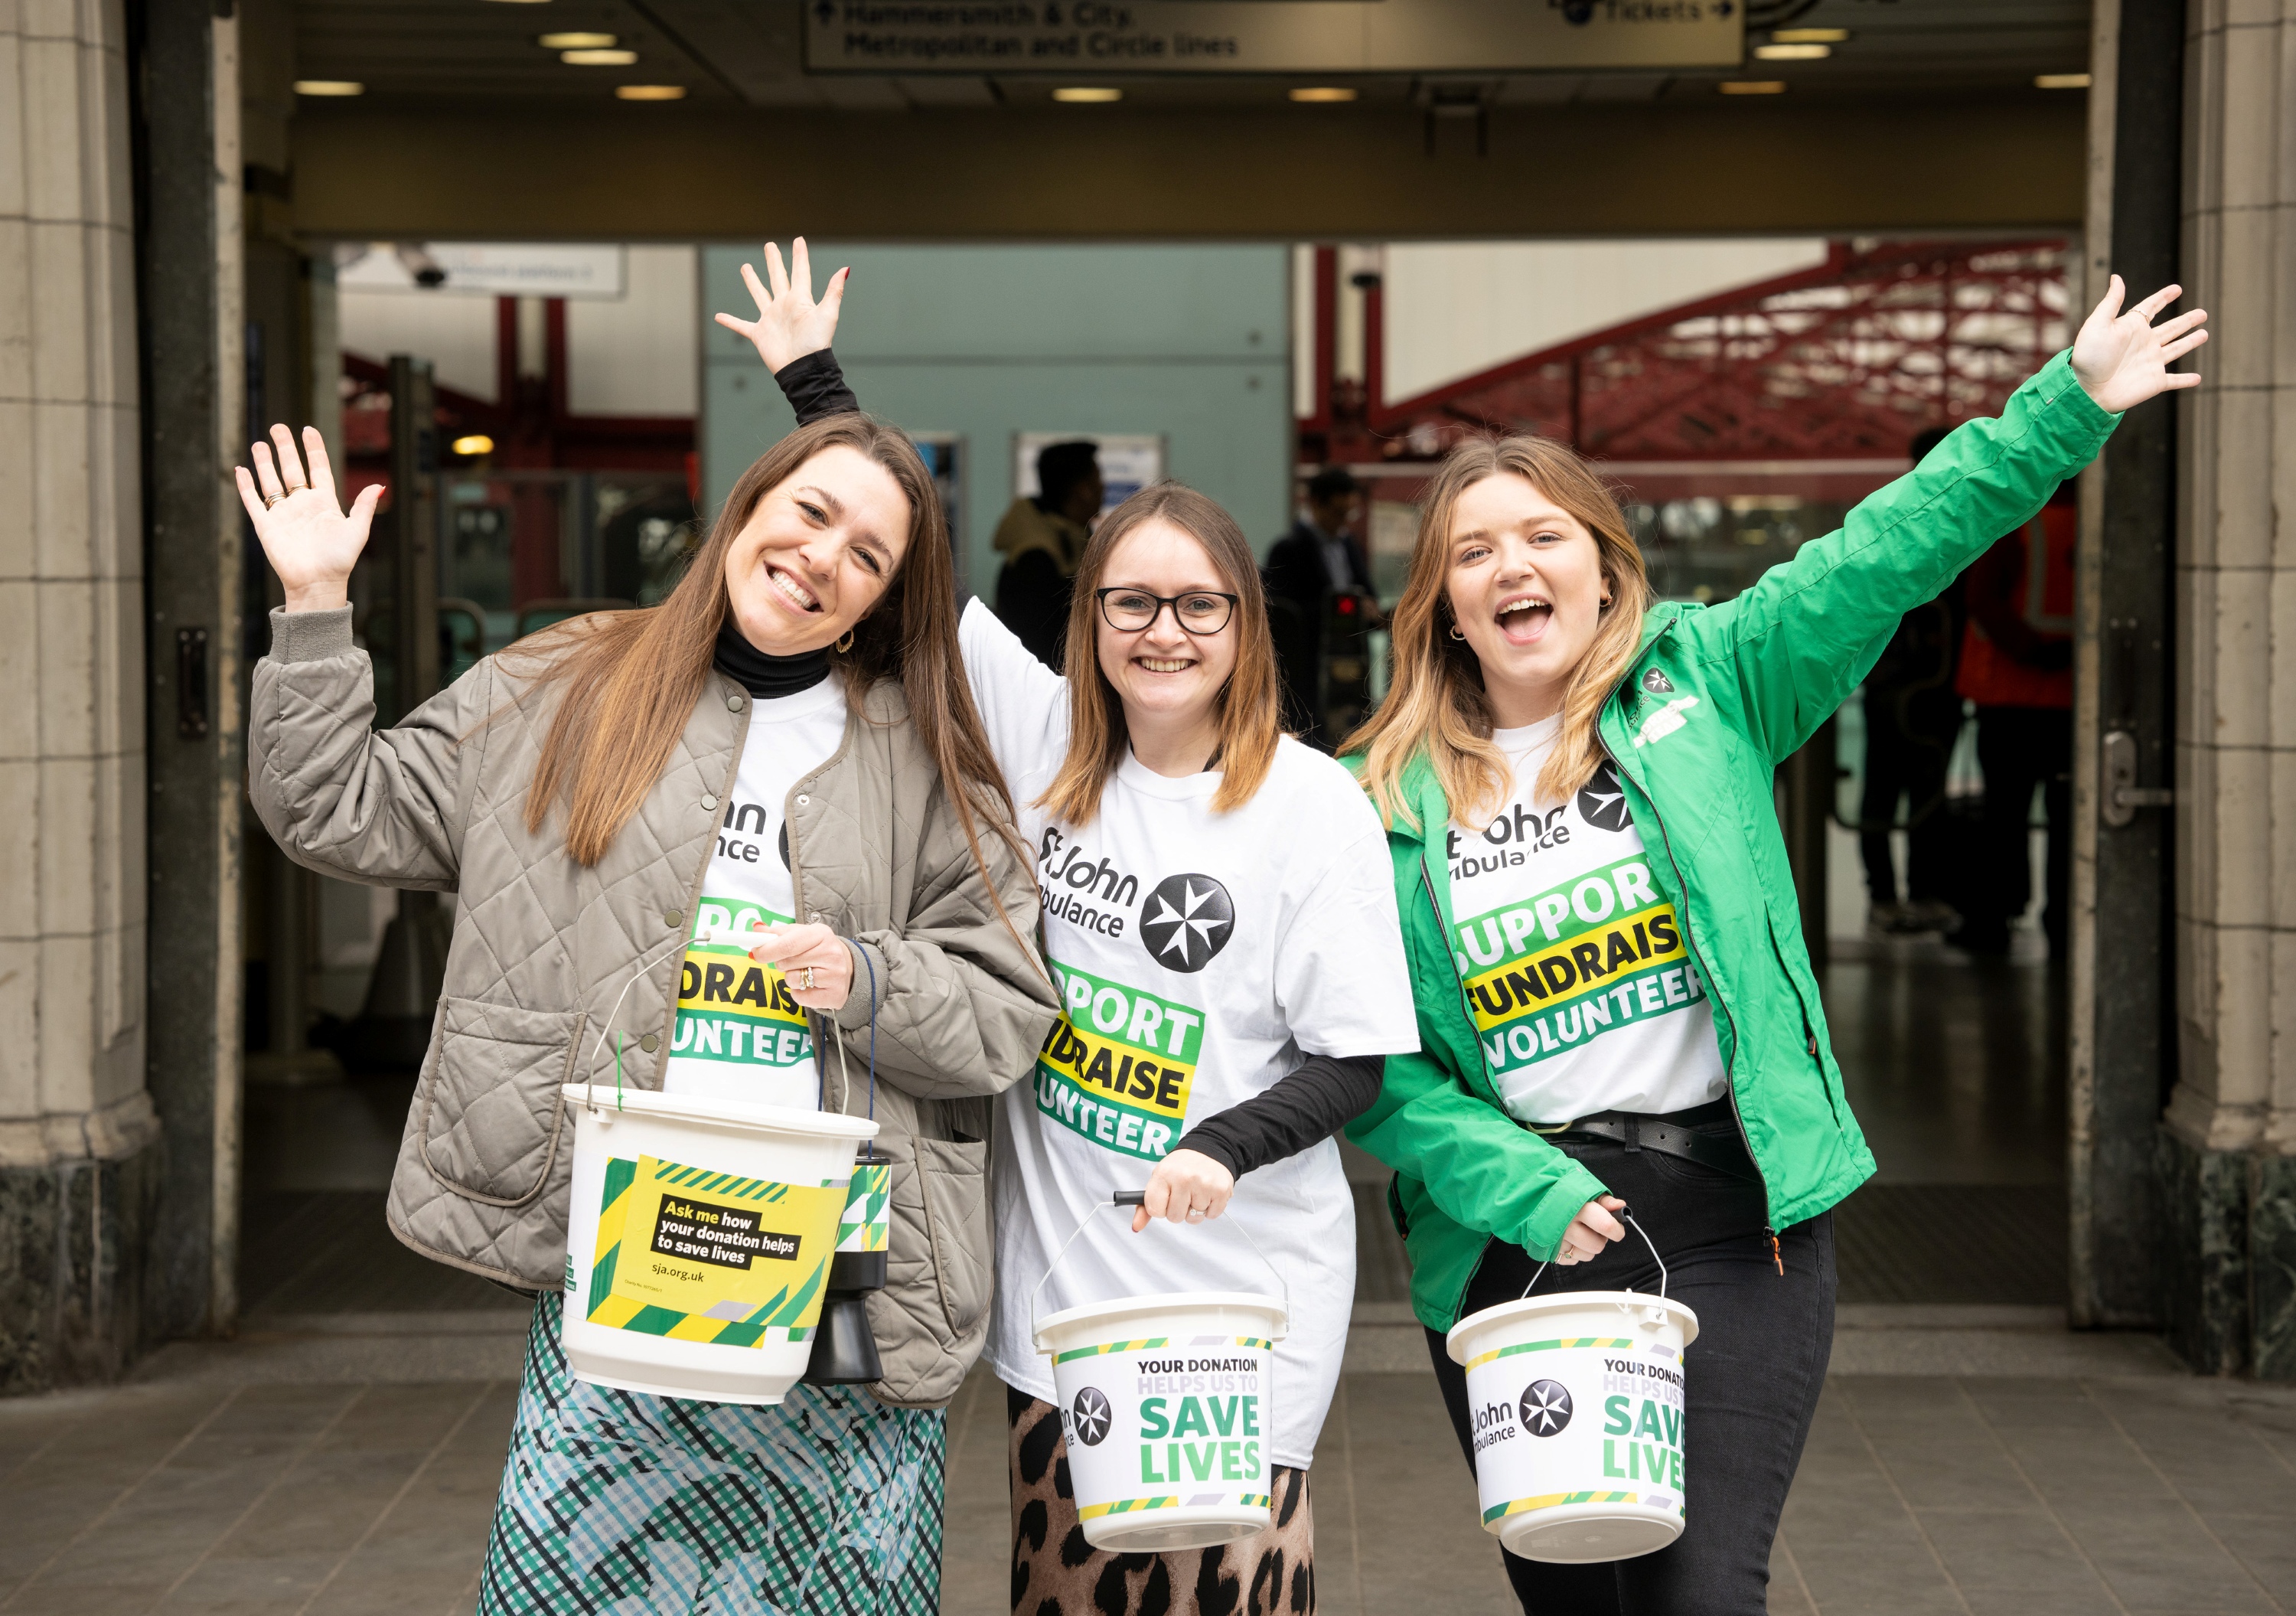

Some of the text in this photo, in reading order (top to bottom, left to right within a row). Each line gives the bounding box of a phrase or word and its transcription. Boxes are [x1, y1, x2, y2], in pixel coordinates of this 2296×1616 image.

[844, 31, 1238, 59] Metropolitan and Circle lines
[1049, 846, 1138, 907] John
[664, 1201, 752, 1229] Ask me how
[657, 1235, 745, 1264] to save lives
[660, 1220, 795, 1255] your donation helps
[651, 1263, 704, 1282] sja.org.uk
[1138, 1359, 1257, 1374] YOUR DONATION
[1603, 1359, 1645, 1376] YOUR
[1137, 1375, 1258, 1395] HELPS US TO
[1603, 1374, 1661, 1399] HELPS
[1664, 1384, 1678, 1405] US
[1140, 1396, 1260, 1439] SAVE
[1476, 1402, 1513, 1434] John
[1140, 1441, 1261, 1484] LIVES
